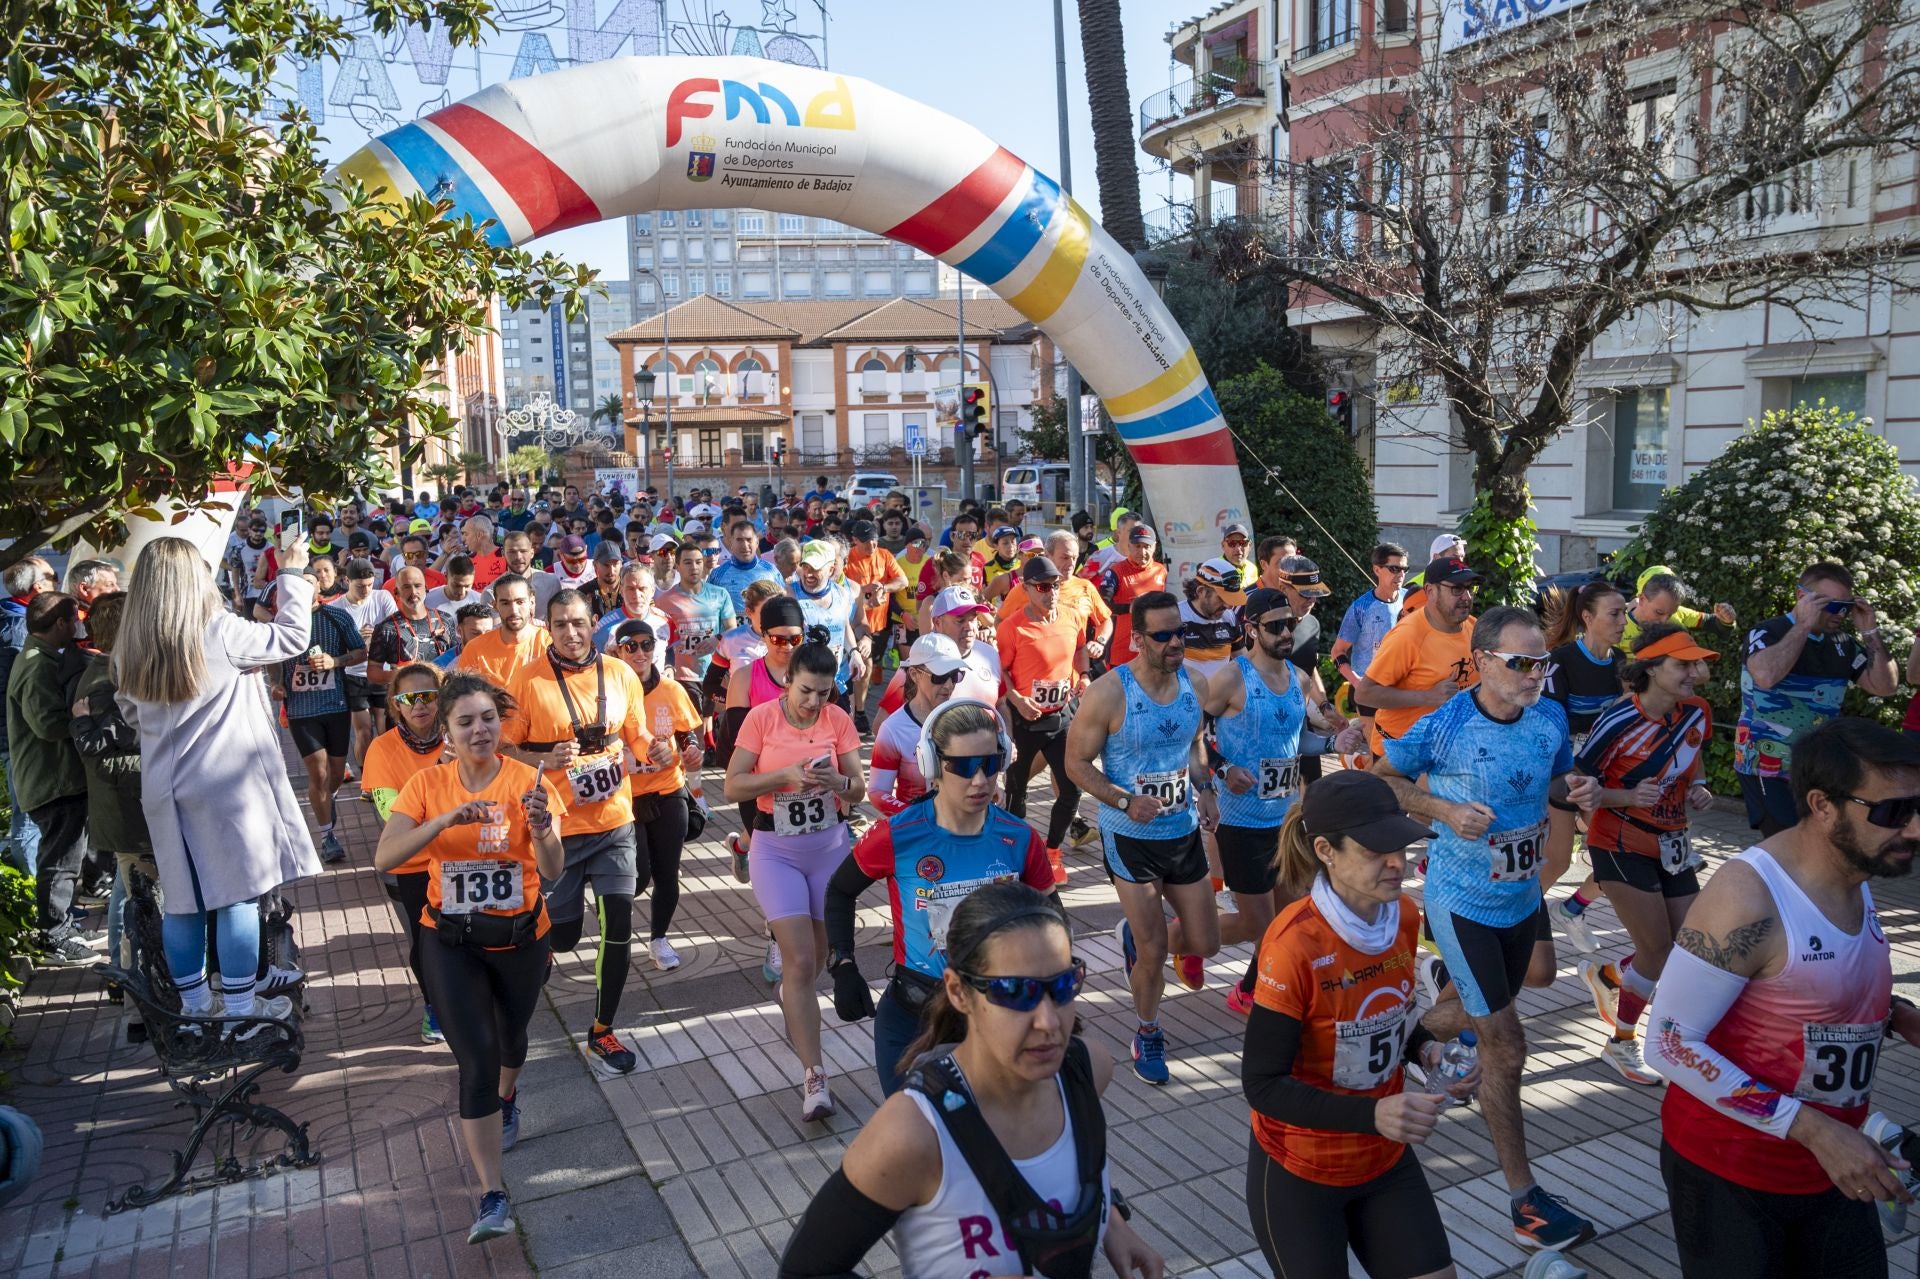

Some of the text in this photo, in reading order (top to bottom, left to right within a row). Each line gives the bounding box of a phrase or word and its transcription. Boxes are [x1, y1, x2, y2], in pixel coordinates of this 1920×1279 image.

[725, 137, 837, 157] Fundación Municipal
[724, 154, 794, 170] de Deportes
[721, 173, 853, 193] Ayuntamiento de Badajoz
[1099, 254, 1166, 343] Fundación Municipal
[1090, 264, 1102, 279] de
[1101, 277, 1133, 322] Deportes
[1142, 332, 1171, 371] Badajoz
[1635, 453, 1668, 466] VENDE
[295, 669, 330, 687] 367
[1035, 685, 1068, 704] 306
[576, 763, 622, 798] 380
[788, 798, 825, 827] 83
[480, 825, 509, 840] RRE
[478, 840, 509, 853] MOS
[450, 870, 513, 904] 138
[1802, 951, 1835, 962] VIATOR
[1369, 1018, 1406, 1074] 51
[1813, 1042, 1876, 1092] 30
